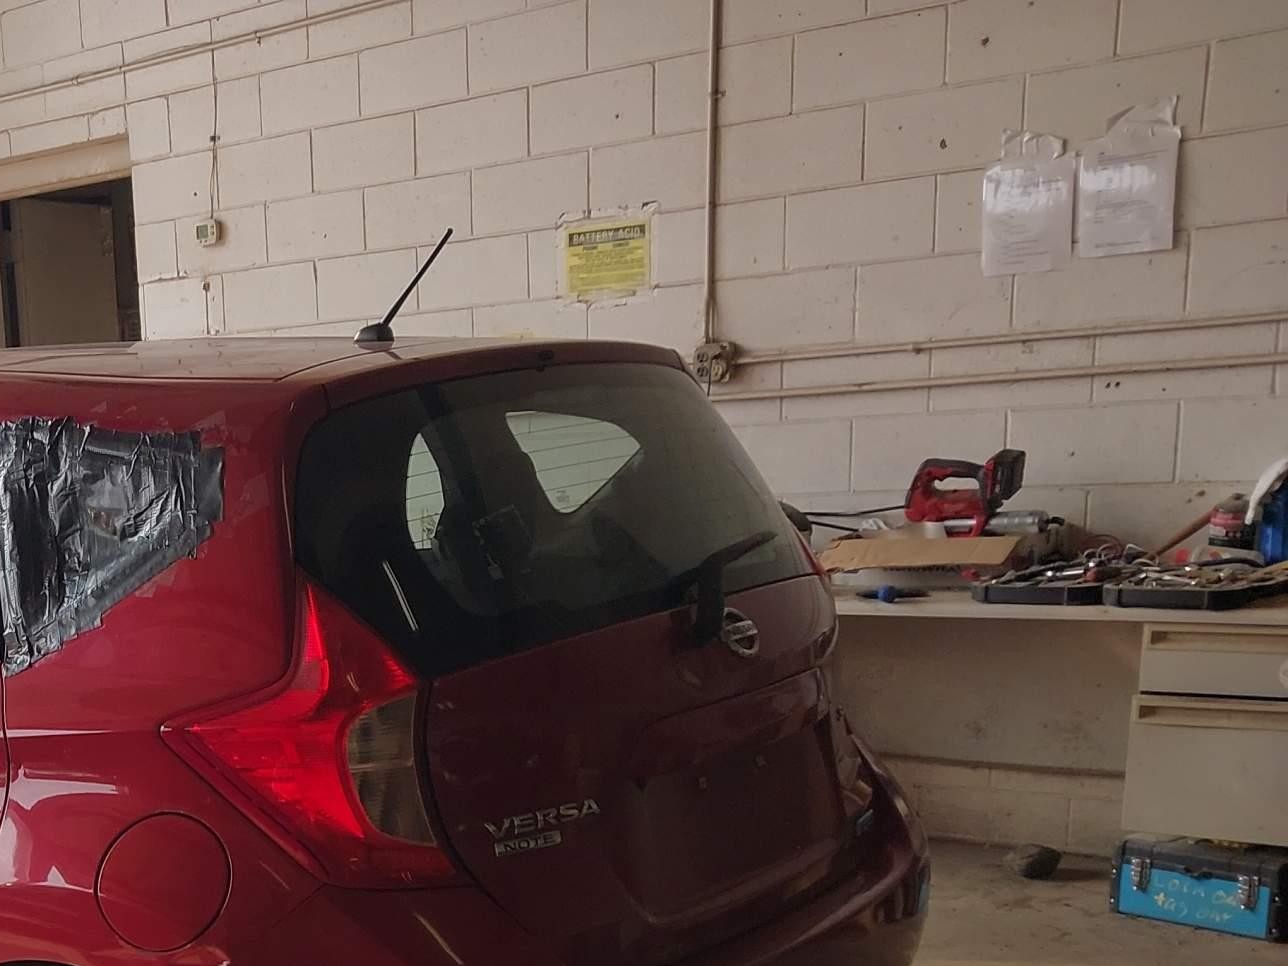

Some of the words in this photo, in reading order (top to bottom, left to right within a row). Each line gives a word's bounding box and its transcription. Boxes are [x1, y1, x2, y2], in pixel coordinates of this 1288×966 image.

[573, 231, 614, 244] BATTERY
[619, 227, 641, 239] ACID
[483, 798, 601, 839] VERSA
